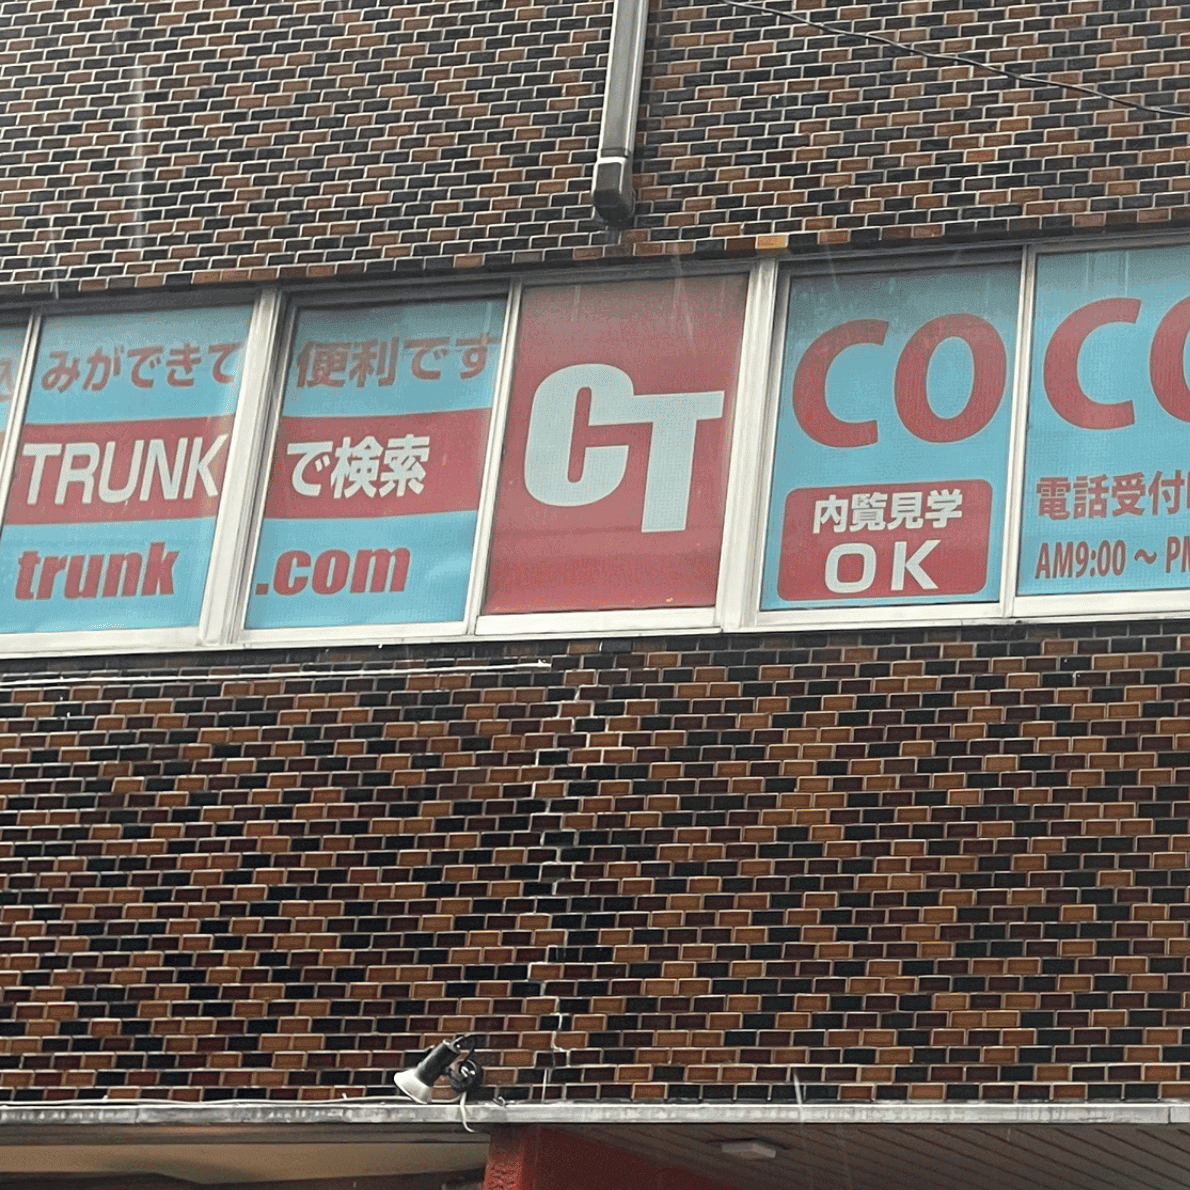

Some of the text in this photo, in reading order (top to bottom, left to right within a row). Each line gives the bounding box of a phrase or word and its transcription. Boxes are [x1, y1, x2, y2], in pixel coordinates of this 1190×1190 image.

[41, 336, 245, 393] みができて
[296, 332, 500, 389] 便利です
[21, 433, 431, 506] TRUNK で検索
[812, 488, 964, 534] 内覧見学
[14, 541, 411, 600] trunk .com
[823, 539, 942, 595] OK
